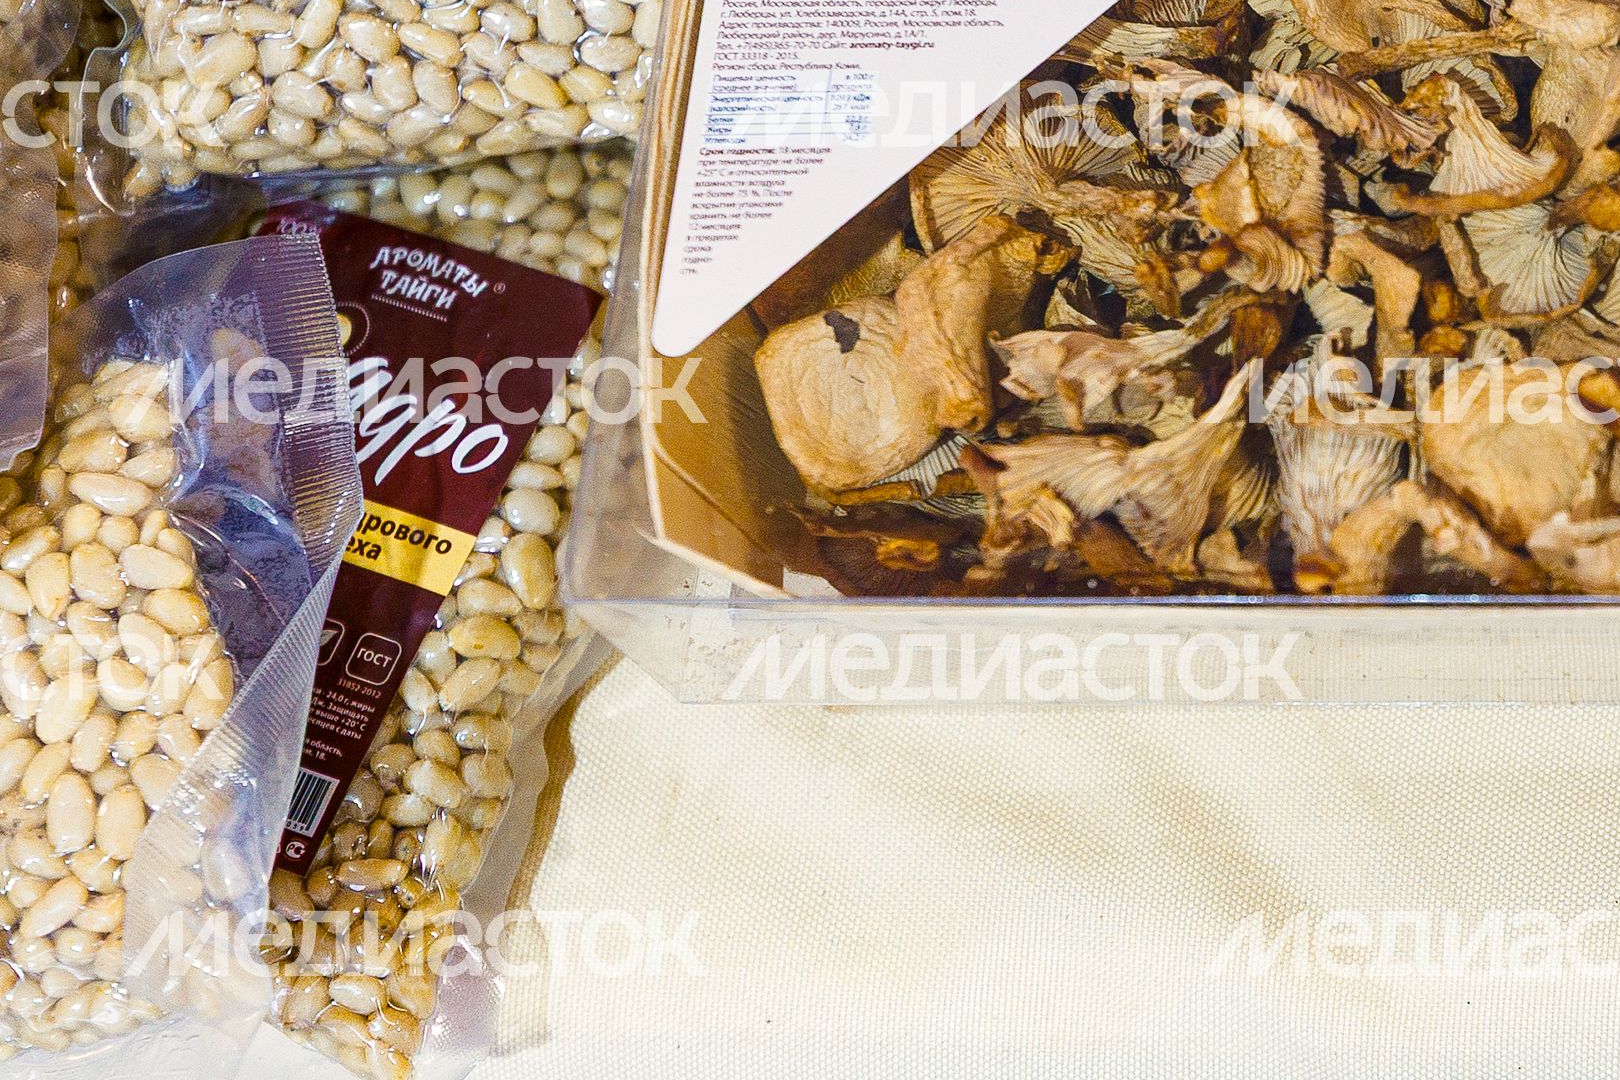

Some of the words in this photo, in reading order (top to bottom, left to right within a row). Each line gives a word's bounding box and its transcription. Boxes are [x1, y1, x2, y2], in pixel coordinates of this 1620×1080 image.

[713, 52, 738, 60] ГОСТ
[370, 246, 488, 298] АРОМАТЫ
[380, 270, 458, 310] ТАЙГИ
[356, 646, 392, 670] ГОСТ
[350, 701, 375, 713] жиры
